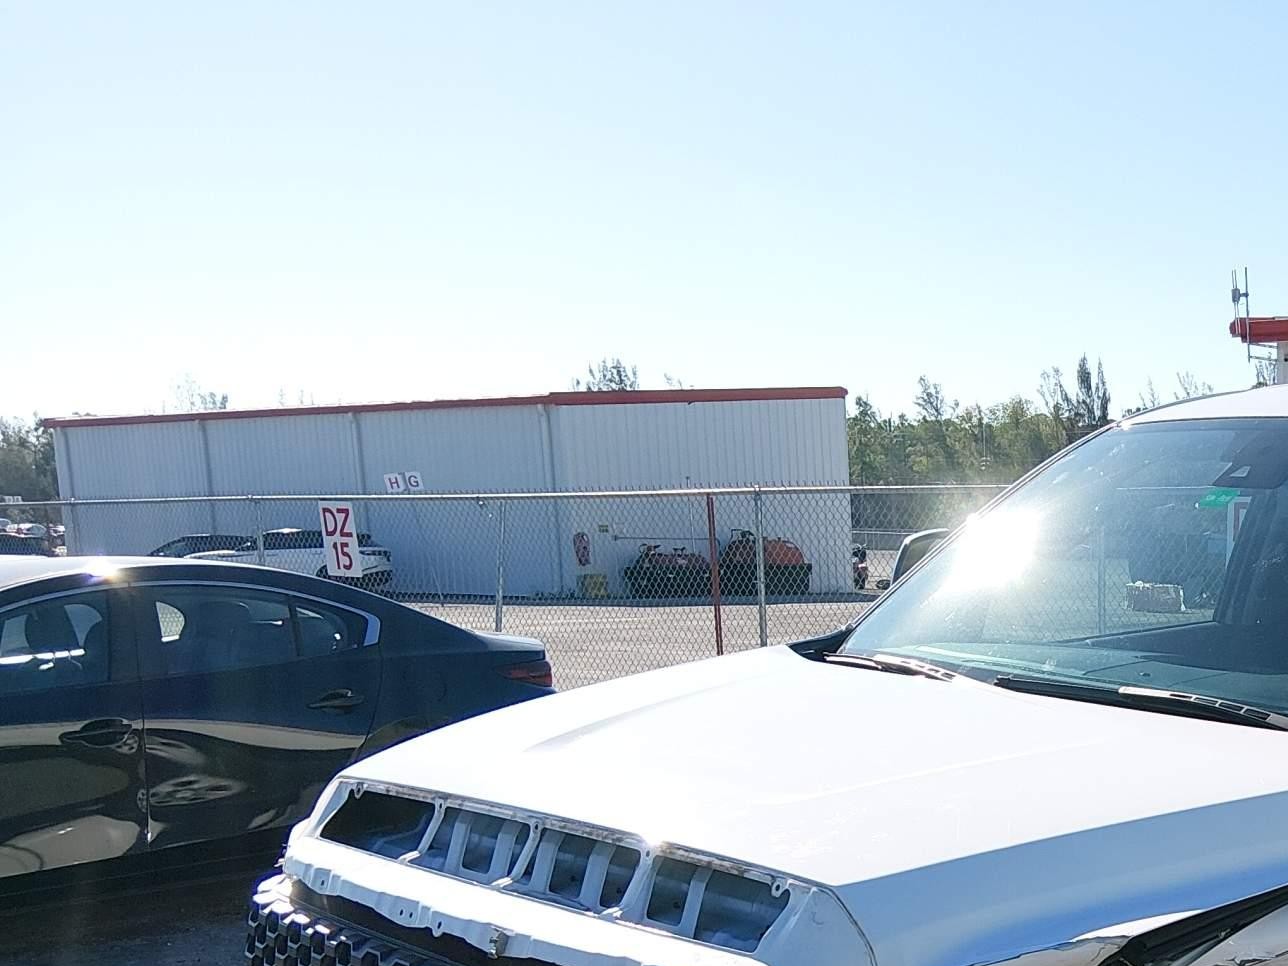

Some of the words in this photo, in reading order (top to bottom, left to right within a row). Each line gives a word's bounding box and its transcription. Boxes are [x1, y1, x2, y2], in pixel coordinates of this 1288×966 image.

[388, 476, 400, 490] H
[407, 475, 419, 488] G
[321, 507, 354, 538] DZ
[332, 541, 354, 571] 15
